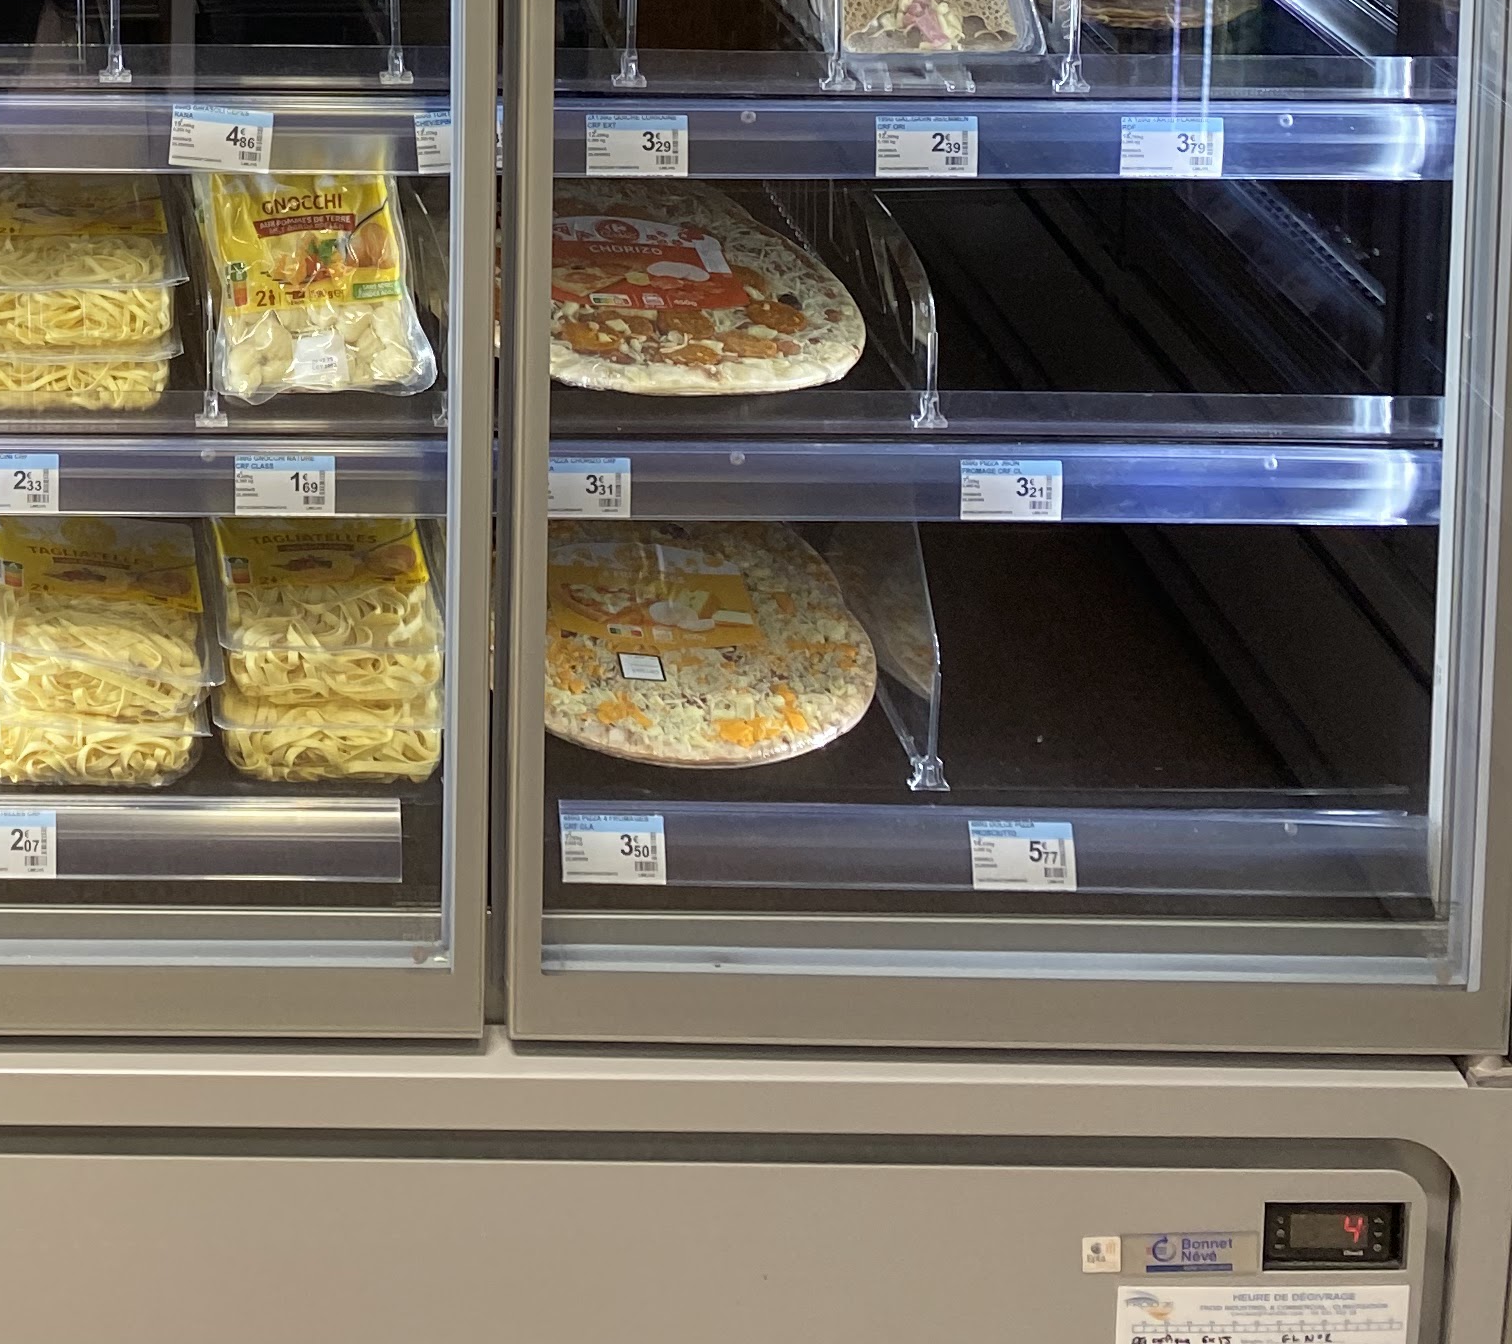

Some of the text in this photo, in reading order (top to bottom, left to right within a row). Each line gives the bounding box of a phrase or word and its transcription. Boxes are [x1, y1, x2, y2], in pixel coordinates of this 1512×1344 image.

[261, 193, 343, 216] GNOCCHI
[589, 243, 663, 257] CHORIZO
[256, 290, 268, 307] 2
[250, 533, 378, 547] TAGLIATELLES
[1343, 1215, 1363, 1243] 4
[1181, 1237, 1233, 1250] Bonnet
[1233, 1293, 1270, 1302] HEURE
